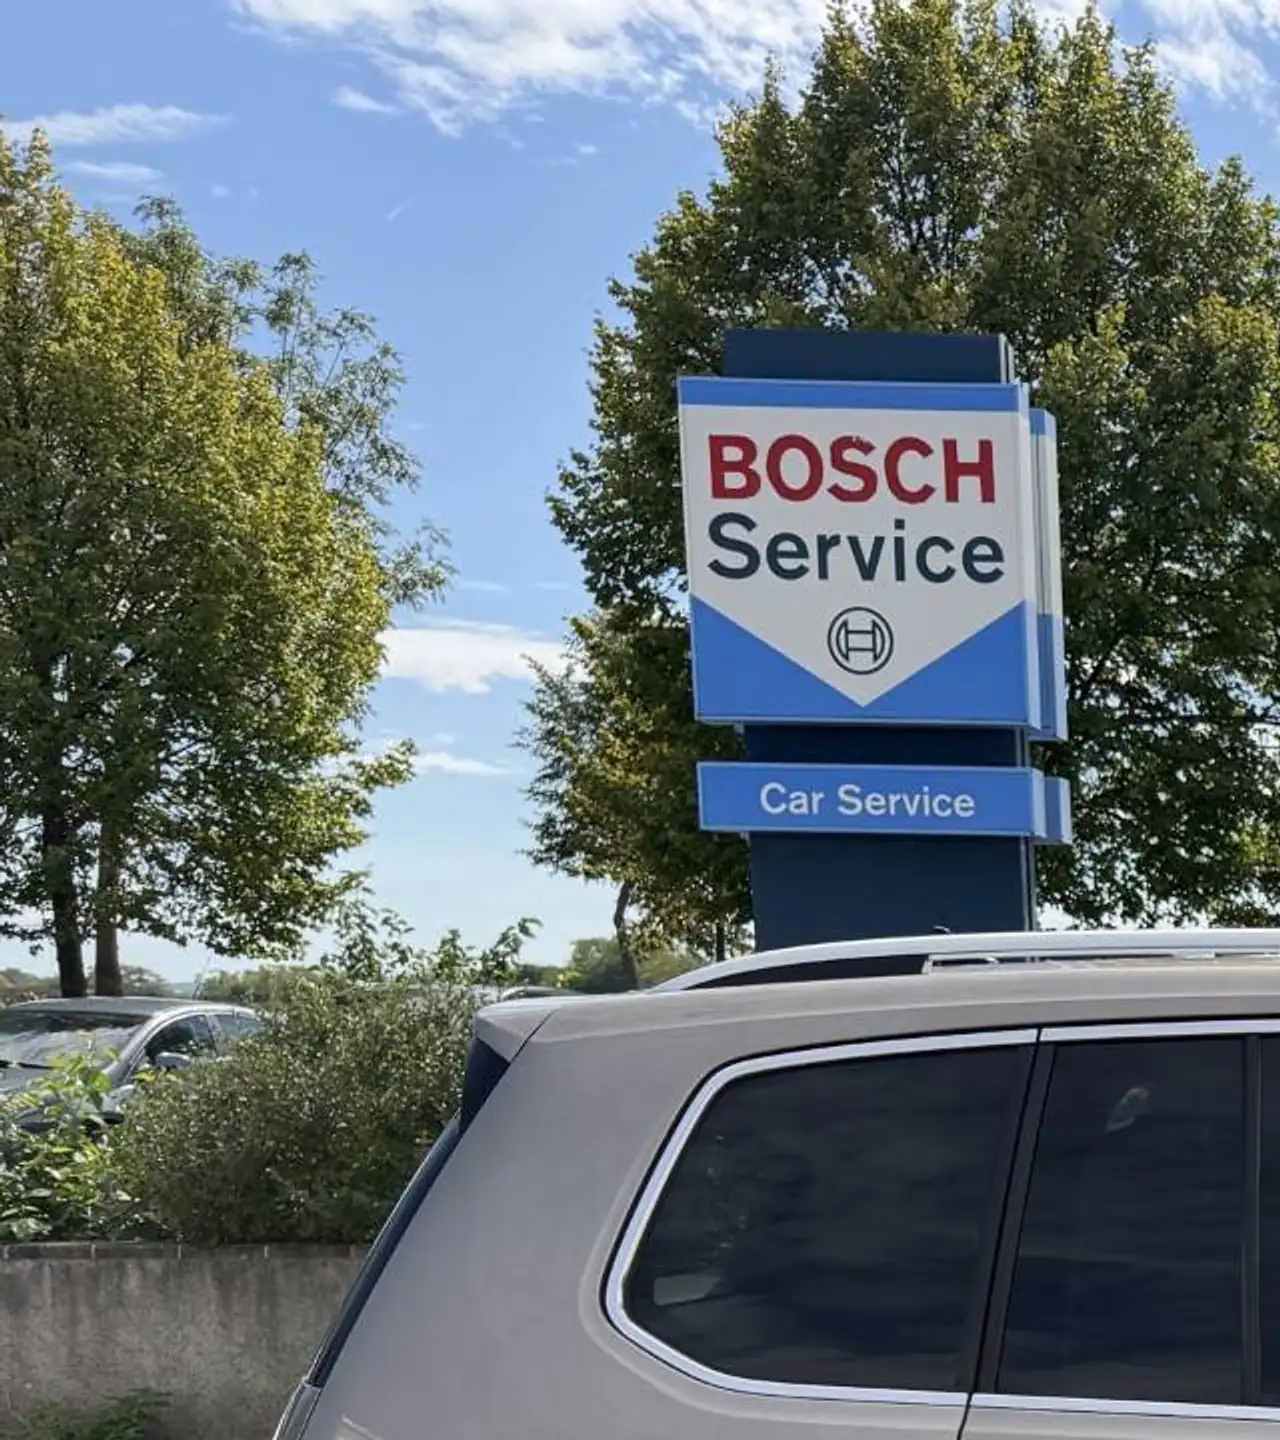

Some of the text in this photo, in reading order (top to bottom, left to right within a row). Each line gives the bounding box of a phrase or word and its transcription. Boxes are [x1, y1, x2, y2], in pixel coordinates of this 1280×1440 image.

[707, 433, 996, 504] BOSCH
[707, 511, 1005, 583] Service
[759, 782, 976, 818] Car Service
